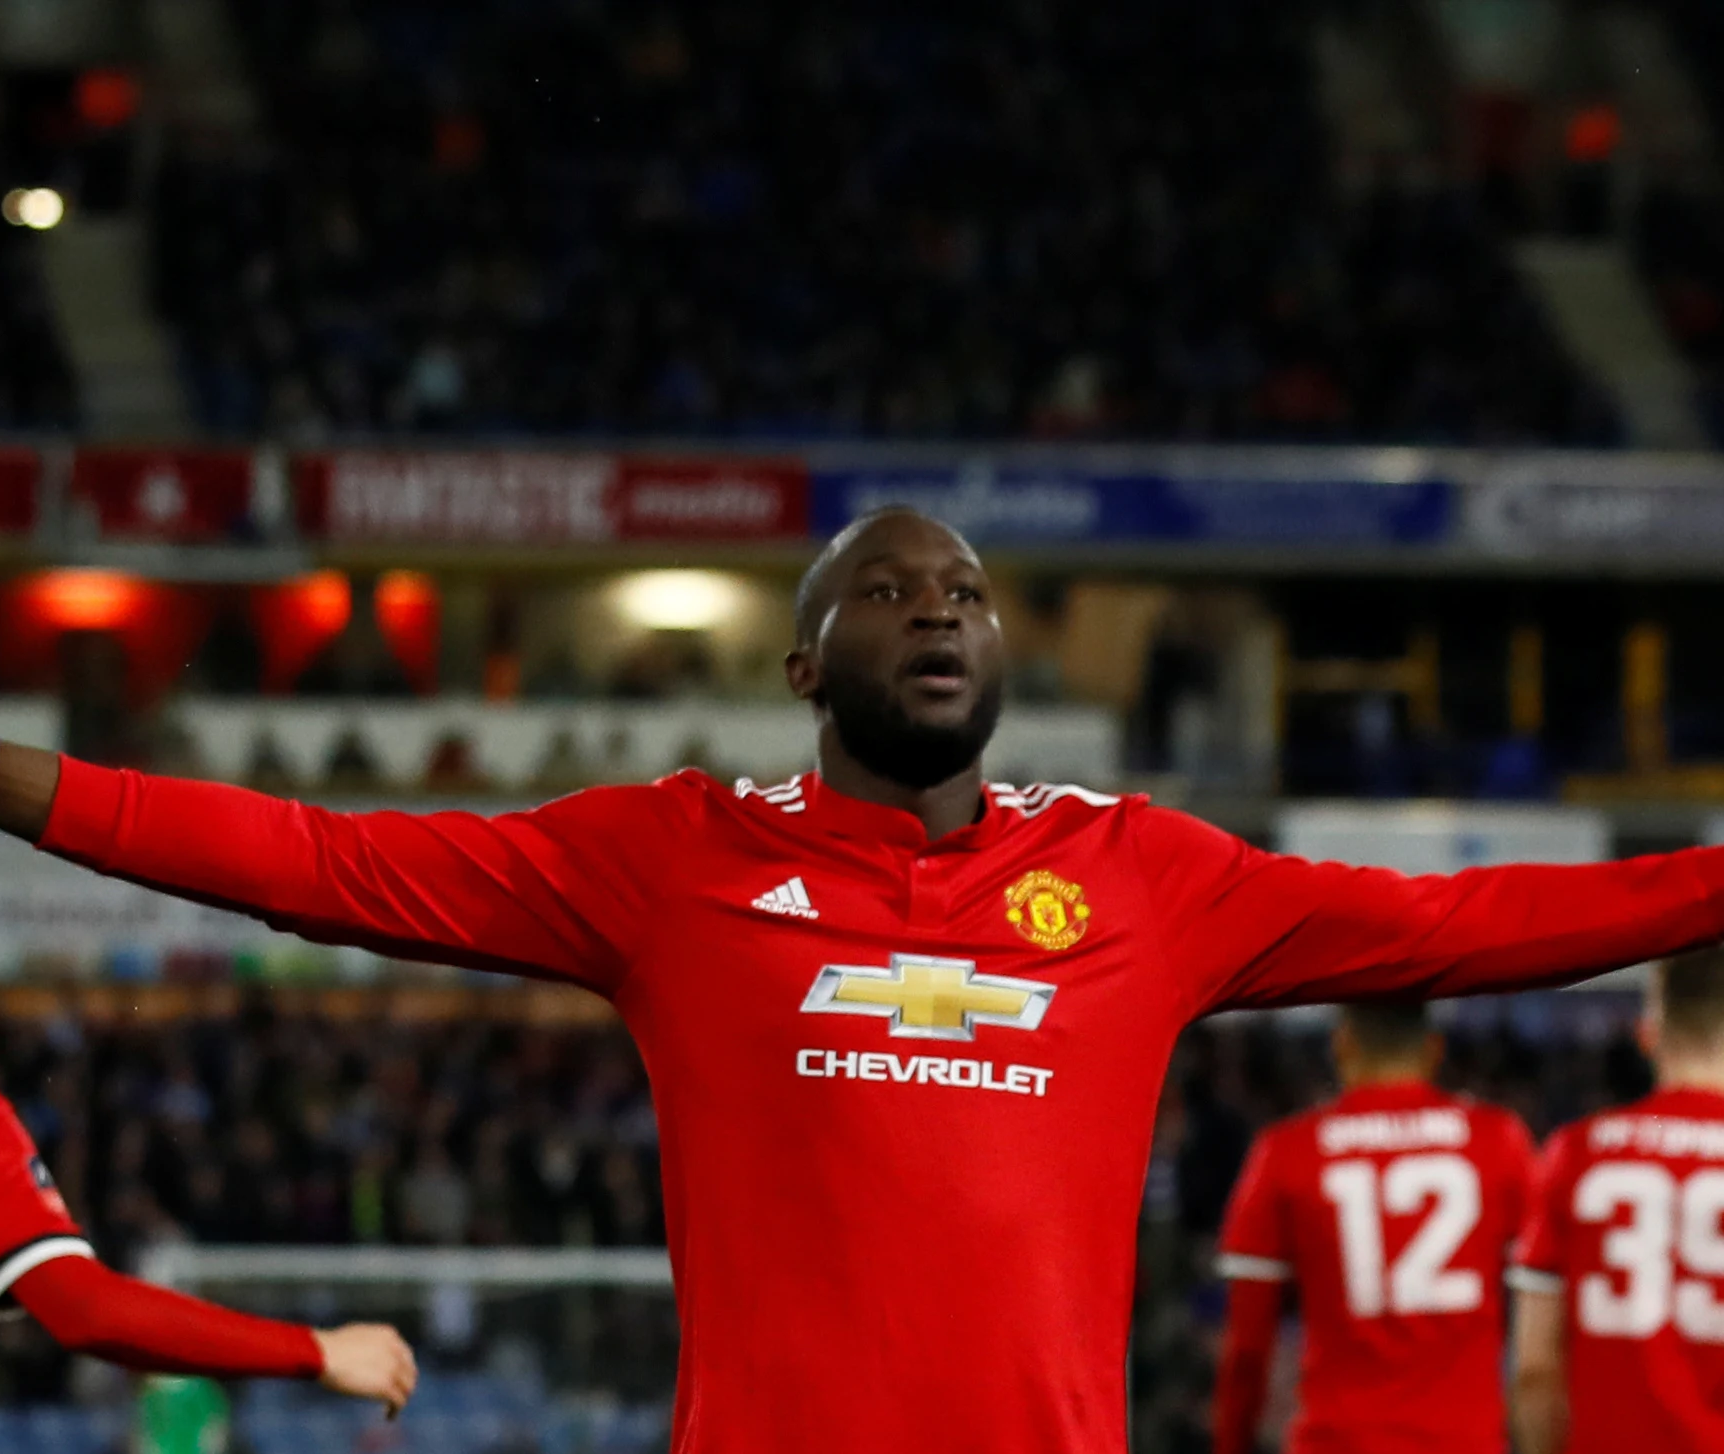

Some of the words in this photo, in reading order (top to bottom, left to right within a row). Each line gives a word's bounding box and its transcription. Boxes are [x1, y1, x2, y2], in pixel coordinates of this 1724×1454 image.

[750, 897, 820, 920] adidas
[796, 1048, 1054, 1097] CHEVROLET
[1319, 1152, 1484, 1319] 12
